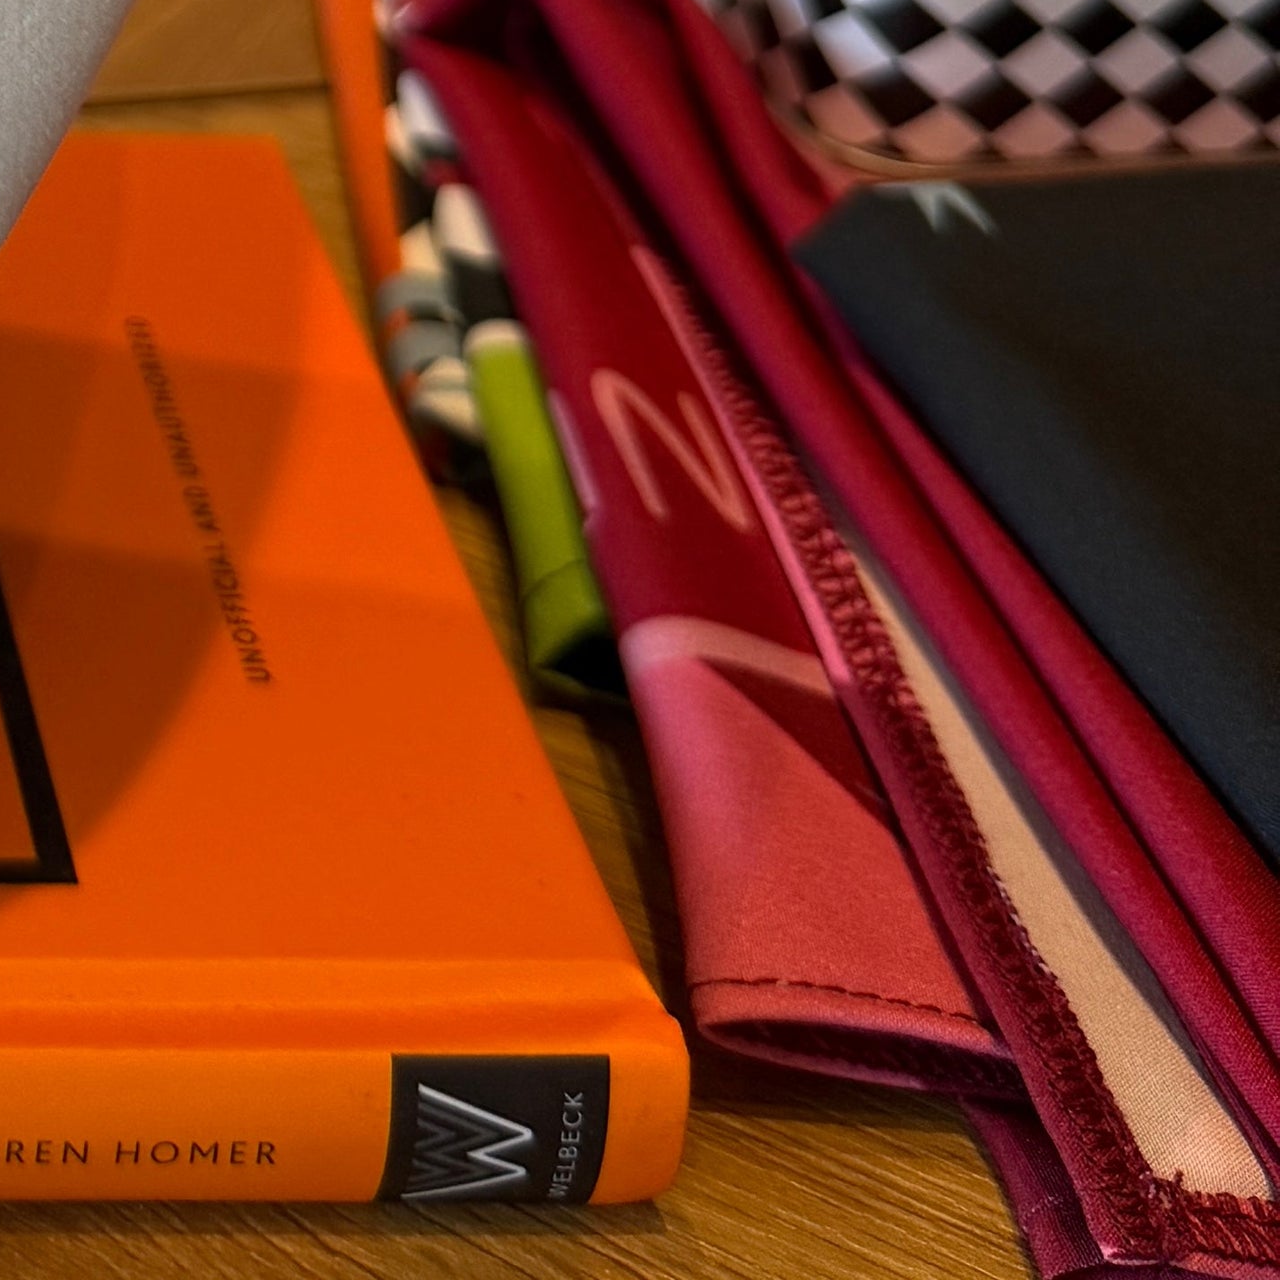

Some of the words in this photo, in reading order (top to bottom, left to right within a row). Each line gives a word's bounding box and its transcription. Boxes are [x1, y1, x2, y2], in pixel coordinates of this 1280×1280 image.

[183, 486, 221, 534] AND
[205, 541, 272, 683] UNOFFICIAL
[114, 1140, 277, 1166] HOMER
[546, 1090, 585, 1199] WELBECK
